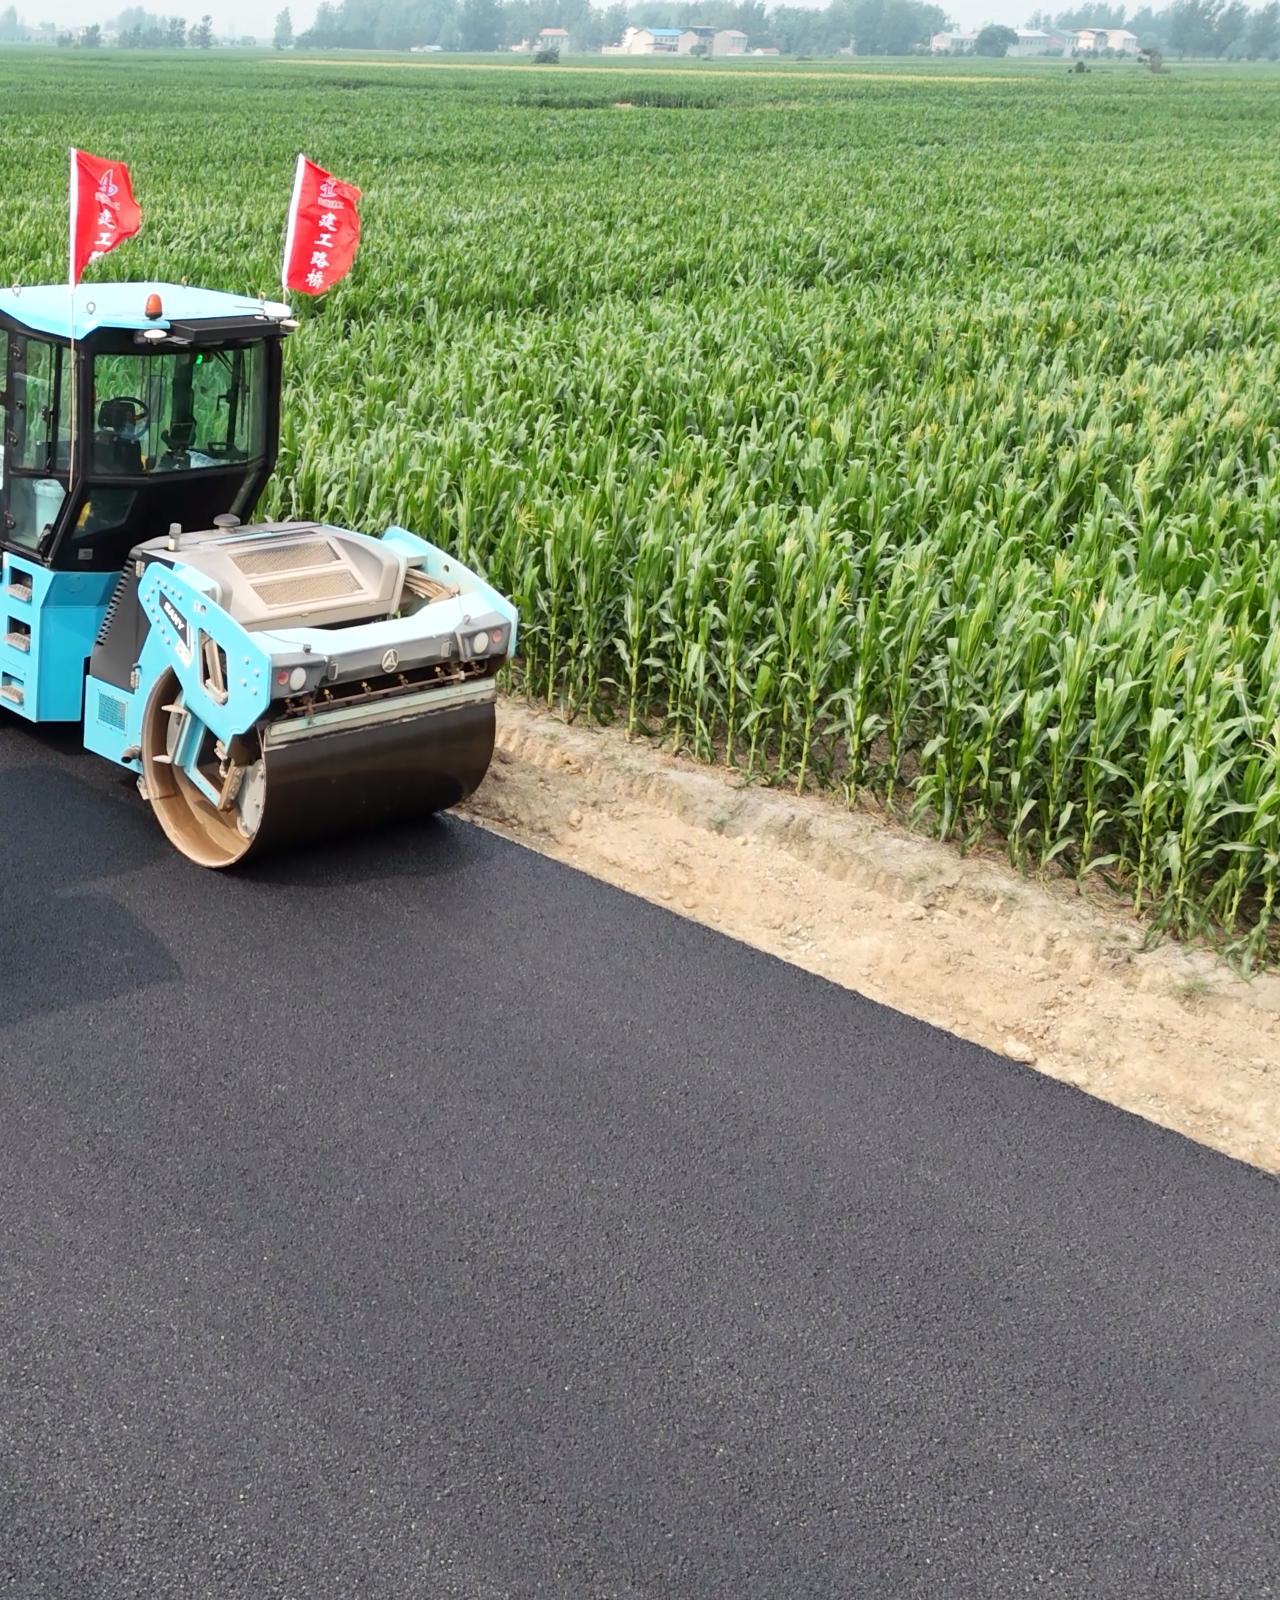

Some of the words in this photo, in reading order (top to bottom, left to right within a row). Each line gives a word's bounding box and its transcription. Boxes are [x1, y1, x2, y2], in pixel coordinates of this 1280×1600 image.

[305, 212, 337, 289] 建工路桥
[163, 601, 185, 630] SANY
